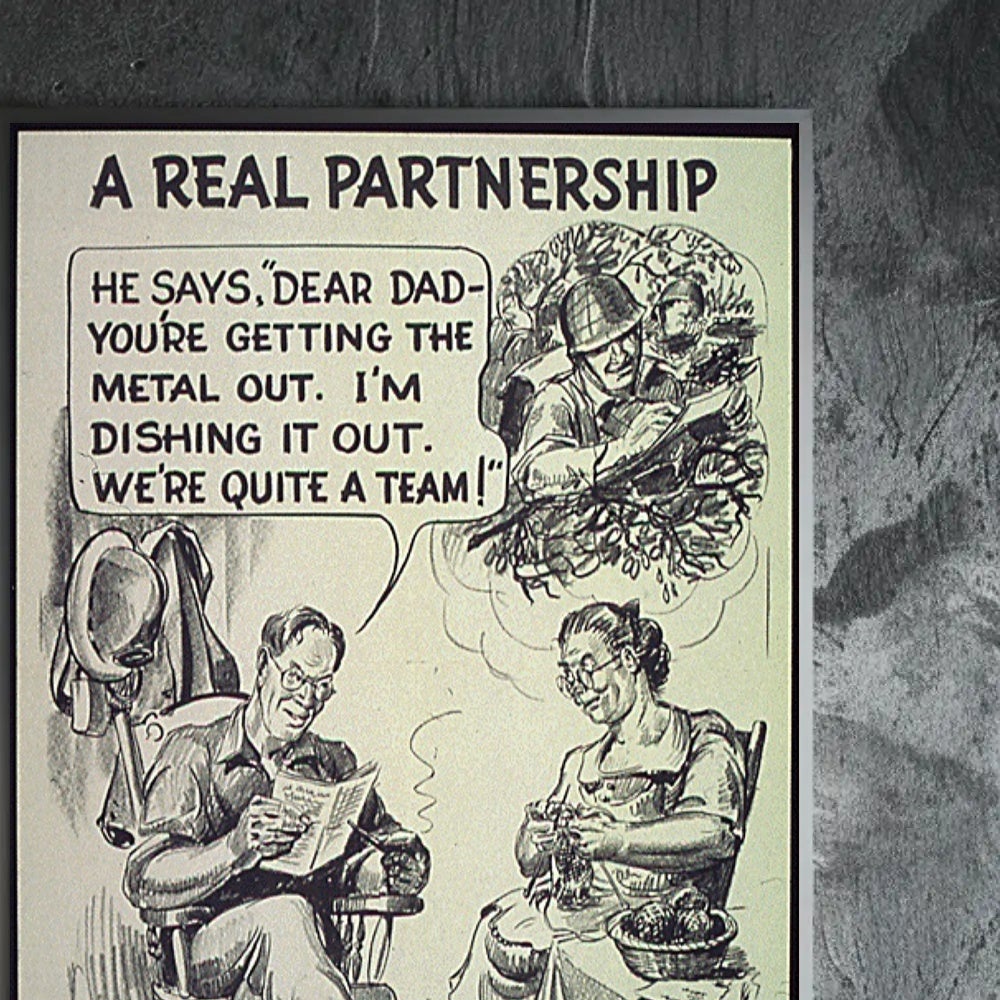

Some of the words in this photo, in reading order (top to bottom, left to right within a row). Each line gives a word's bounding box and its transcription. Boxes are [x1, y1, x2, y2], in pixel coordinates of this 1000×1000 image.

[89, 153, 133, 210] A
[152, 153, 309, 210] REAL
[324, 153, 718, 213] PARTNERSHIP
[91, 271, 140, 305] HE
[389, 269, 485, 306] DAD-
[87, 309, 208, 355] YOU'RE
[225, 321, 393, 354] GETTING
[404, 320, 474, 353] THE
[92, 373, 220, 404] METAL
[236, 373, 323, 403] OUT.
[355, 365, 421, 404] I'M
[90, 420, 261, 456] DISHING
[283, 422, 319, 454] IT
[332, 422, 433, 454] OUT.
[92, 462, 206, 505] WE'RE
[221, 469, 327, 510] QUITE
[340, 470, 367, 503] A
[375, 455, 504, 506] TEAM!"
